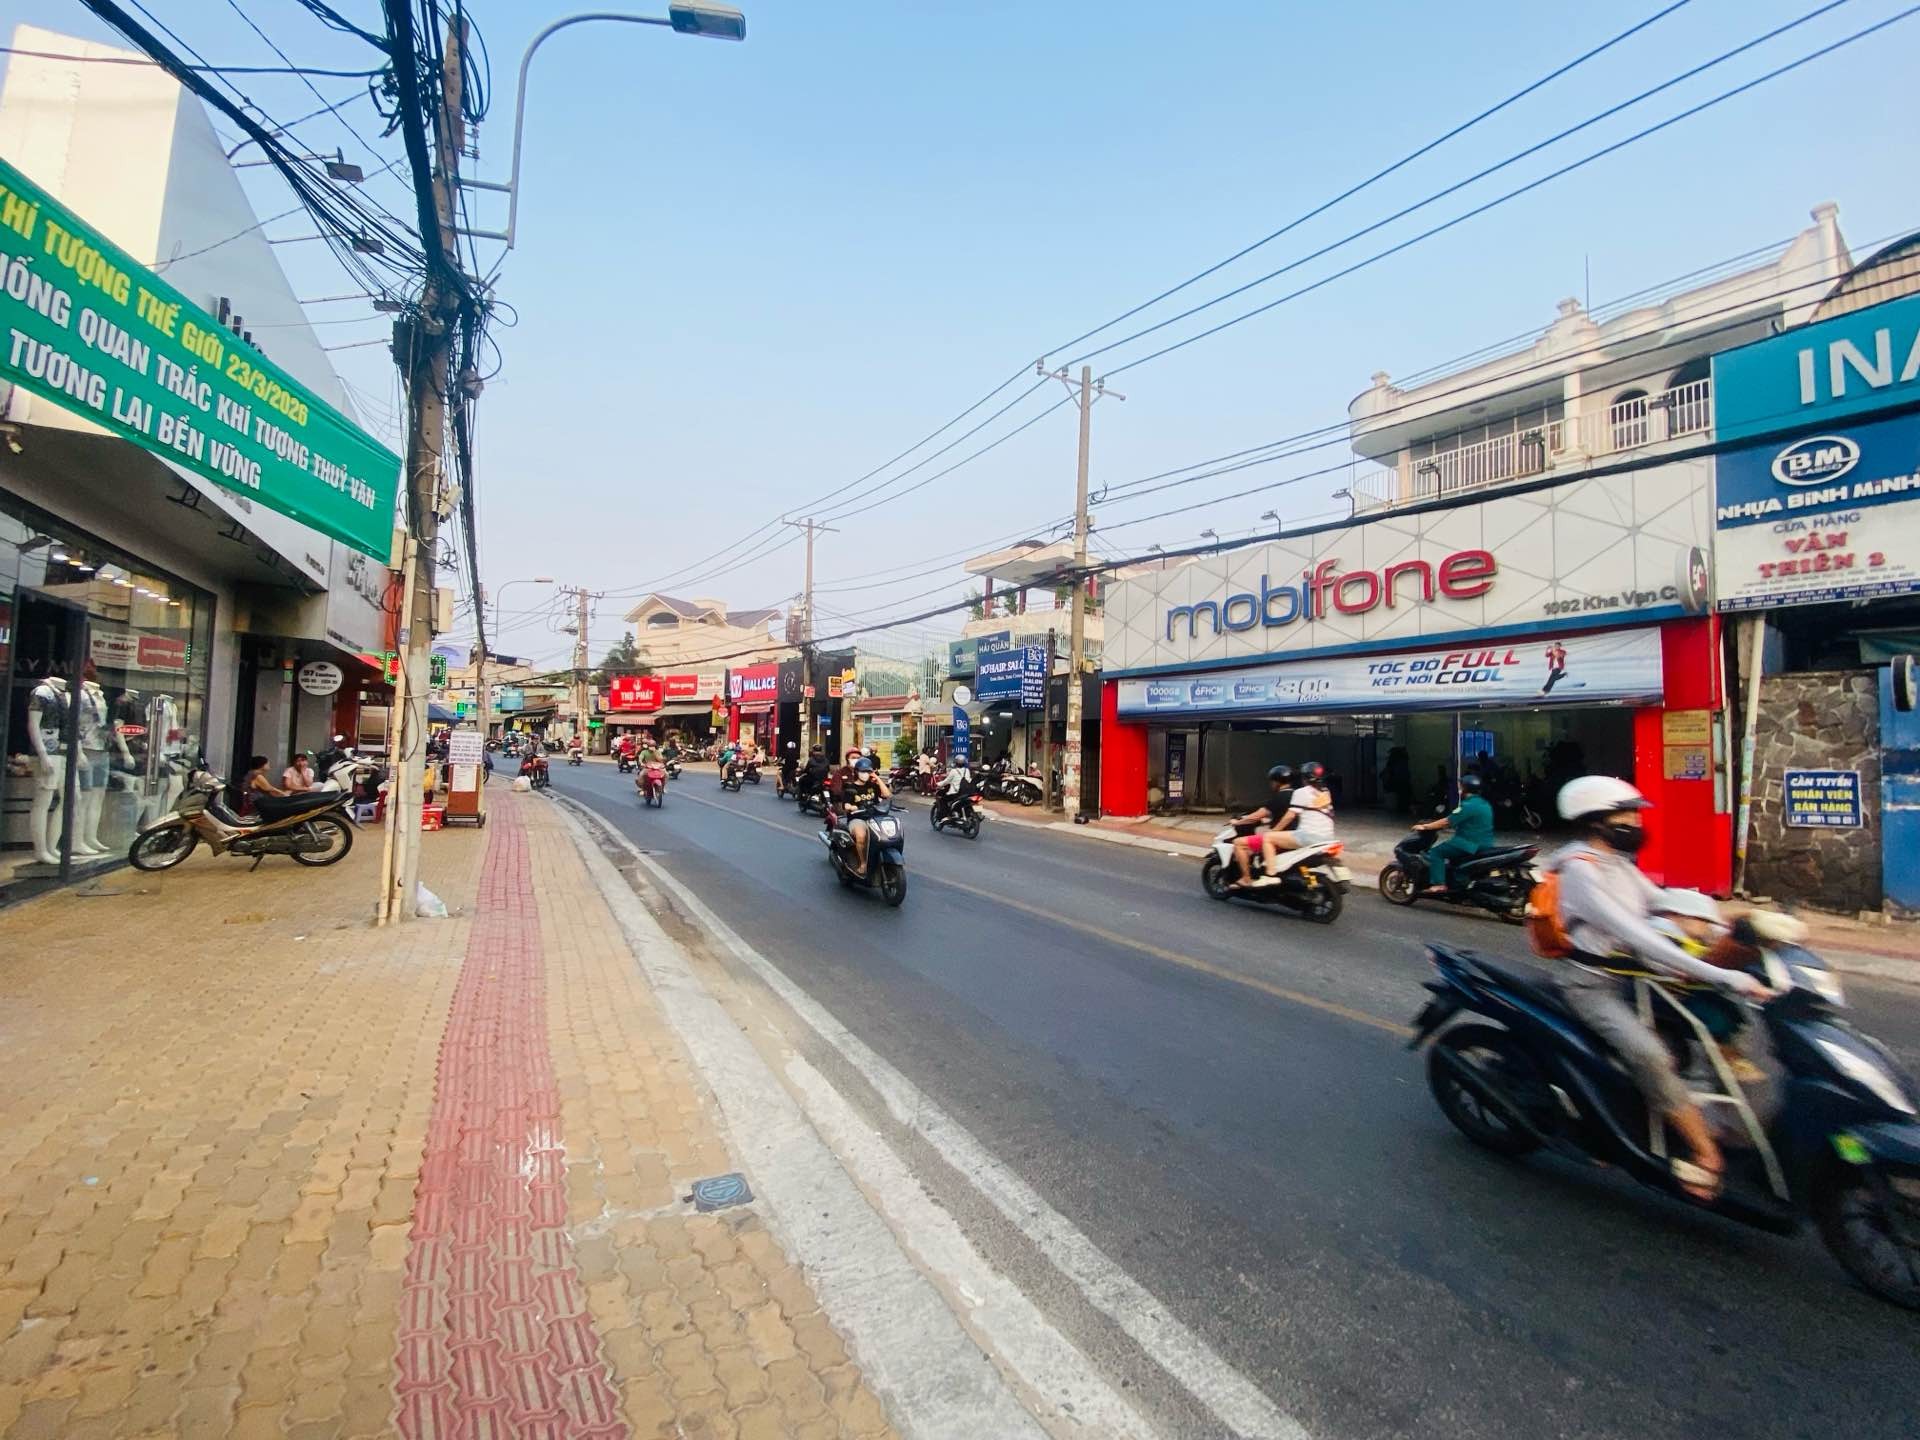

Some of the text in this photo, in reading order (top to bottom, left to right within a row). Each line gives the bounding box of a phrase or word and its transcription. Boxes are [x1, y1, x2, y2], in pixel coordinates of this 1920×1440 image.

[44, 219, 131, 306] TƯỢNG
[136, 286, 183, 338] THẾ
[181, 321, 224, 370] GIỚI
[226, 353, 310, 428] 23/3/2026
[78, 307, 151, 377] QUAN
[156, 353, 212, 412] TRẮC
[216, 392, 252, 436] KHÍ
[255, 416, 309, 471] TƯỢNG
[9, 328, 262, 490] TƯƠNG LAI BỀN VỮNG
[1717, 498, 1783, 520] NHỰA
[1773, 510, 1861, 534] CỬA HÀNG
[1869, 551, 1885, 567] 2
[1167, 549, 1498, 641] mobifone
[1544, 598, 1580, 616] 1092
[1368, 660, 1407, 675] TỐC
[1441, 649, 1521, 670] FULL
[743, 677, 776, 690] WALLACE
[1372, 668, 1506, 687] KẾT NỐI COOL
[1790, 773, 1853, 787] CẦN TUYỂN
[1792, 789, 1853, 800] NHÂN VIÊN
